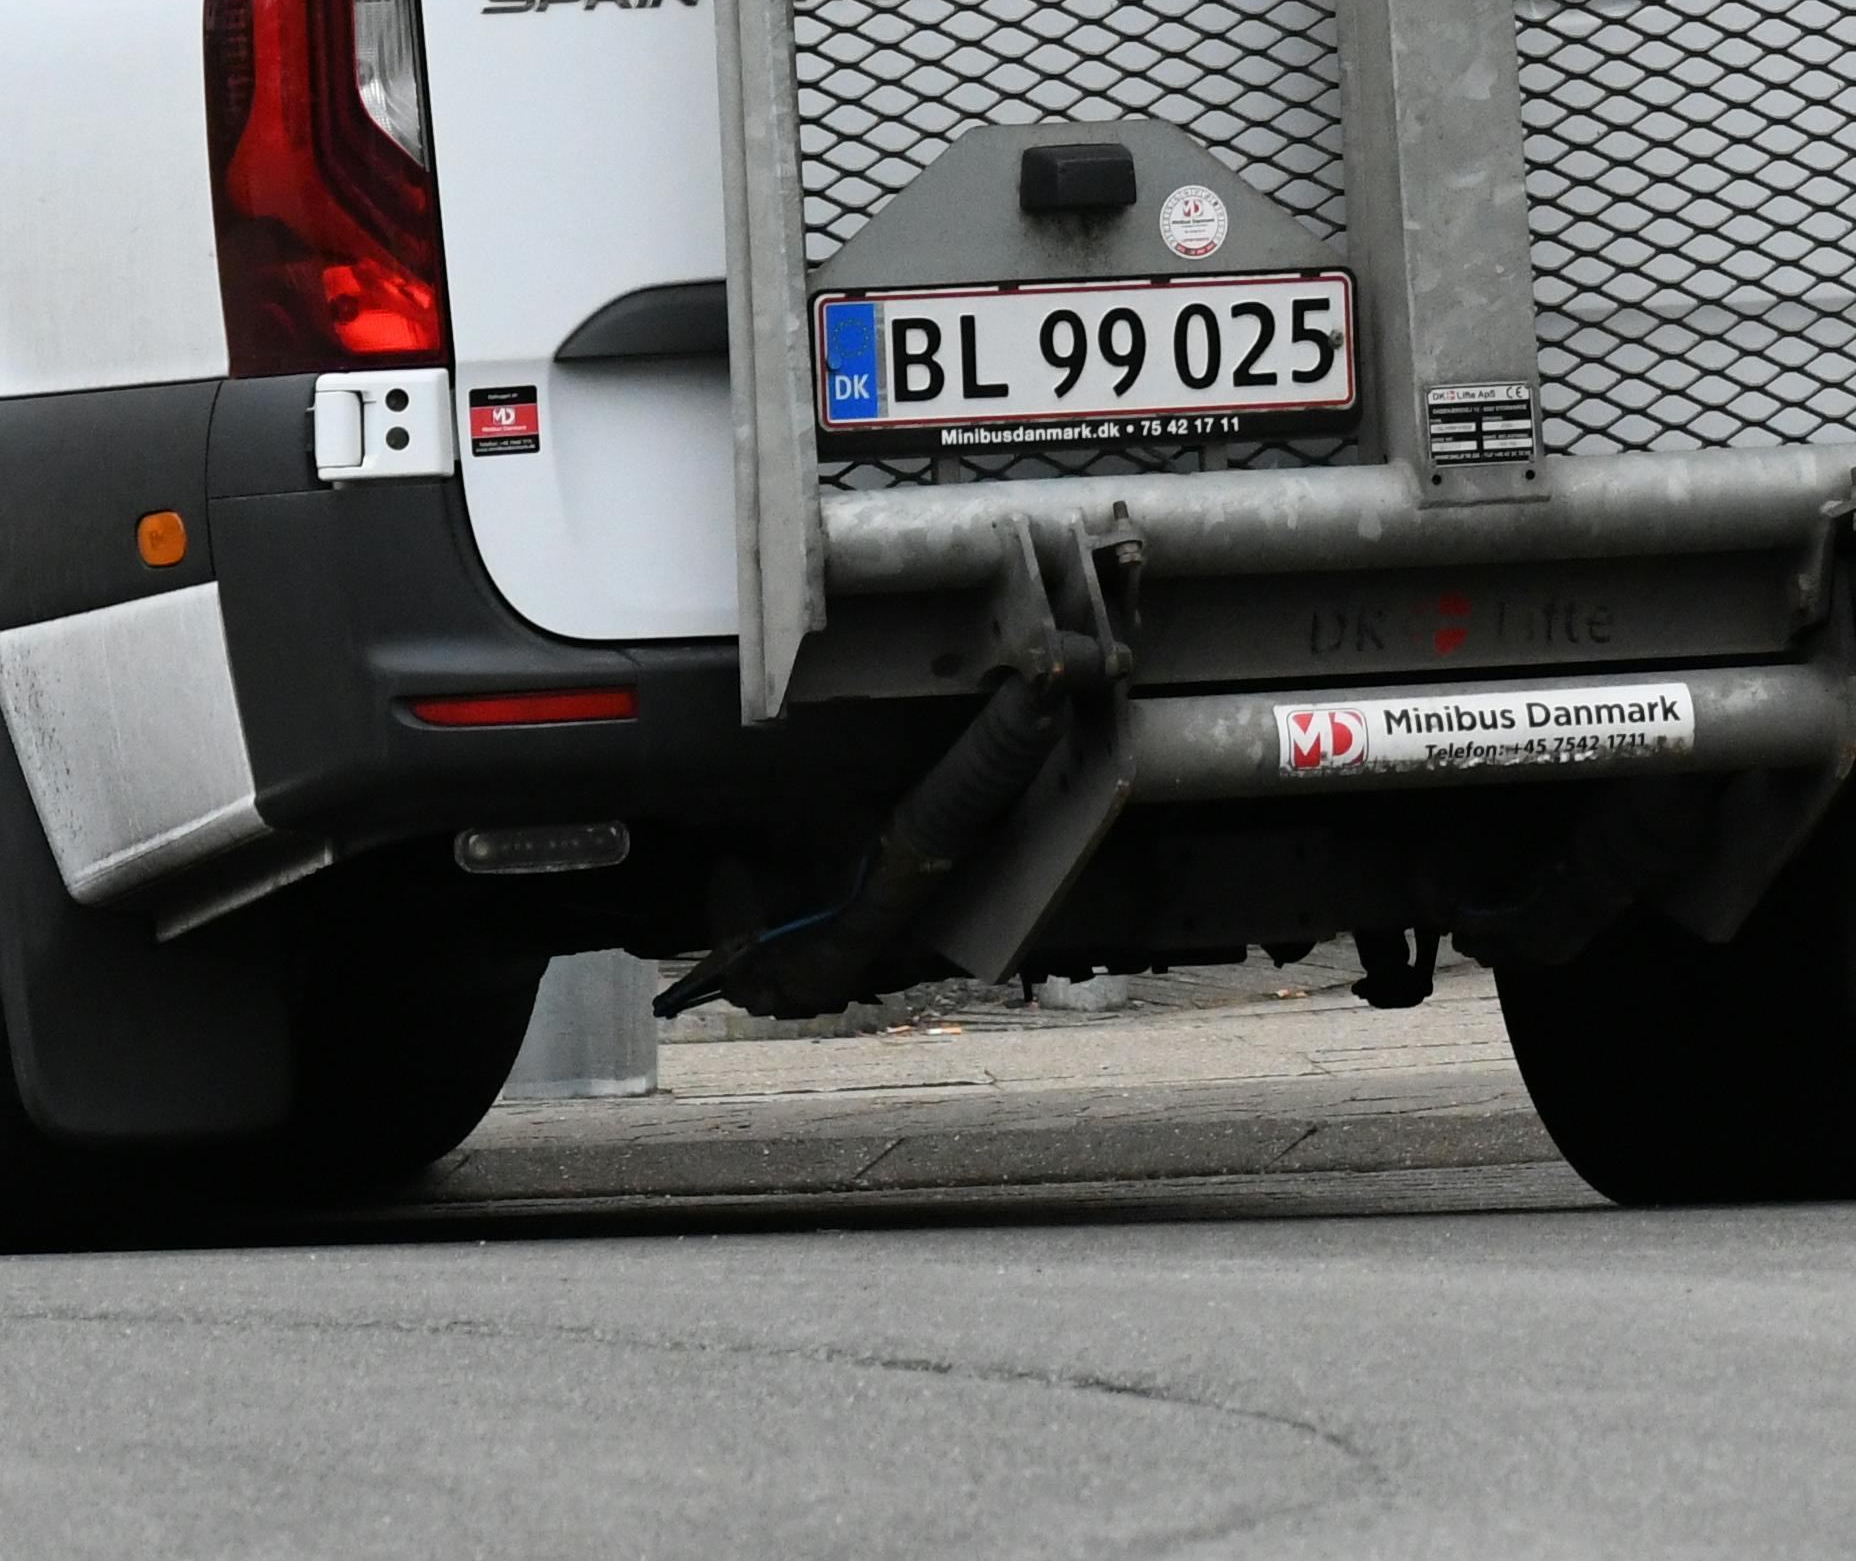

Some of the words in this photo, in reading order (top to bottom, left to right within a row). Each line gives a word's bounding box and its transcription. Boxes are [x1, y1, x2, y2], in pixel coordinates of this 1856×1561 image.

[892, 315, 1009, 402] BL
[1039, 307, 1147, 399] 99
[1174, 298, 1336, 390] 025
[834, 373, 870, 400] DK
[941, 421, 1120, 446] Minibusdanmark.dk
[1141, 420, 1161, 436] 75
[1167, 419, 1188, 435] 42
[1195, 418, 1213, 433] 17
[1220, 417, 1239, 432] 11
[1383, 704, 1516, 735] Minibus
[1528, 695, 1680, 728] Danmark
[1425, 739, 1505, 760] Telefon:
[1554, 735, 1600, 753] 7542
[1607, 732, 1646, 749] 1711
